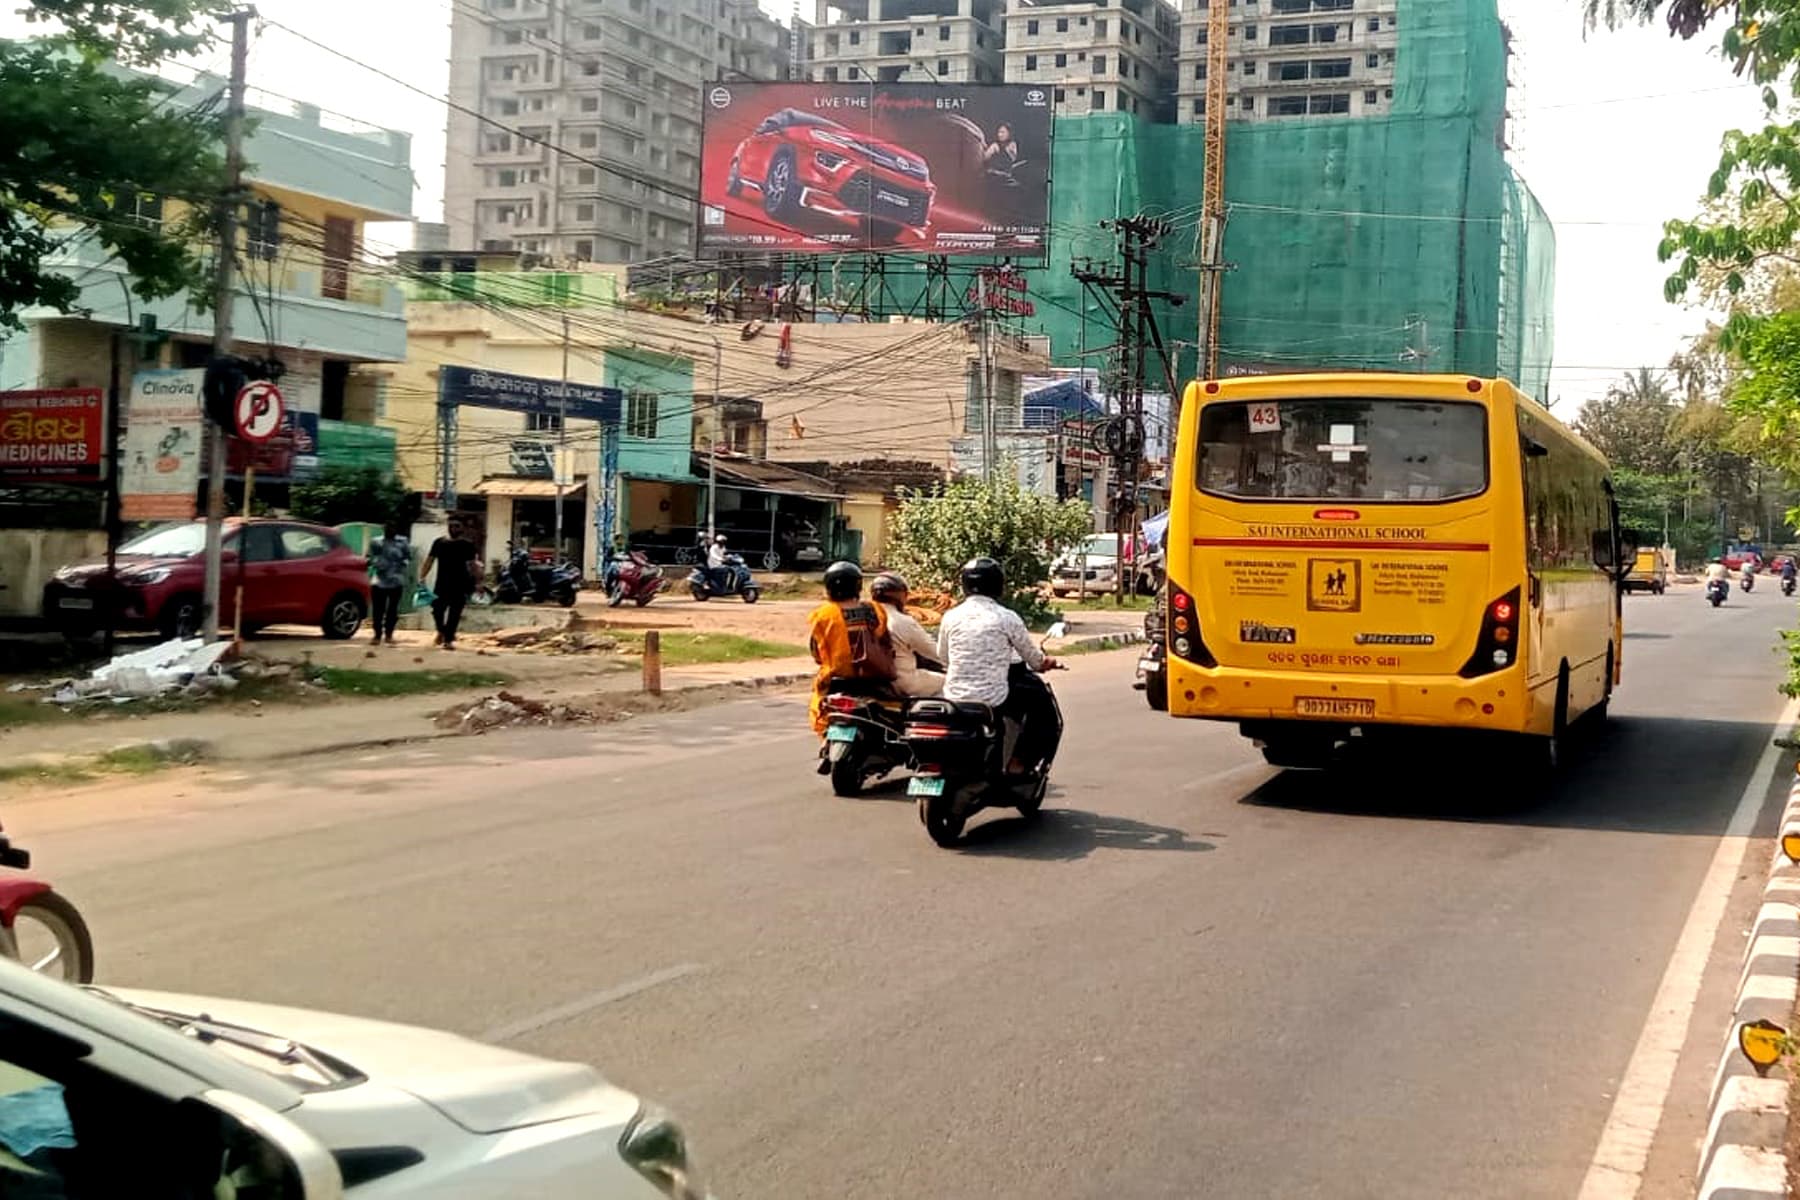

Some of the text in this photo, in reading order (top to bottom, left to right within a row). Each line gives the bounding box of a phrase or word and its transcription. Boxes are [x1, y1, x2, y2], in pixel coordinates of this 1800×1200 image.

[813, 96, 841, 108] LIVE
[844, 96, 868, 108] THE
[935, 97, 967, 109] BEAT
[1252, 407, 1277, 425] 43
[1248, 525, 1428, 541] SAI INTERNATIONAL SCHOOL
[1243, 626, 1292, 642] TATA
